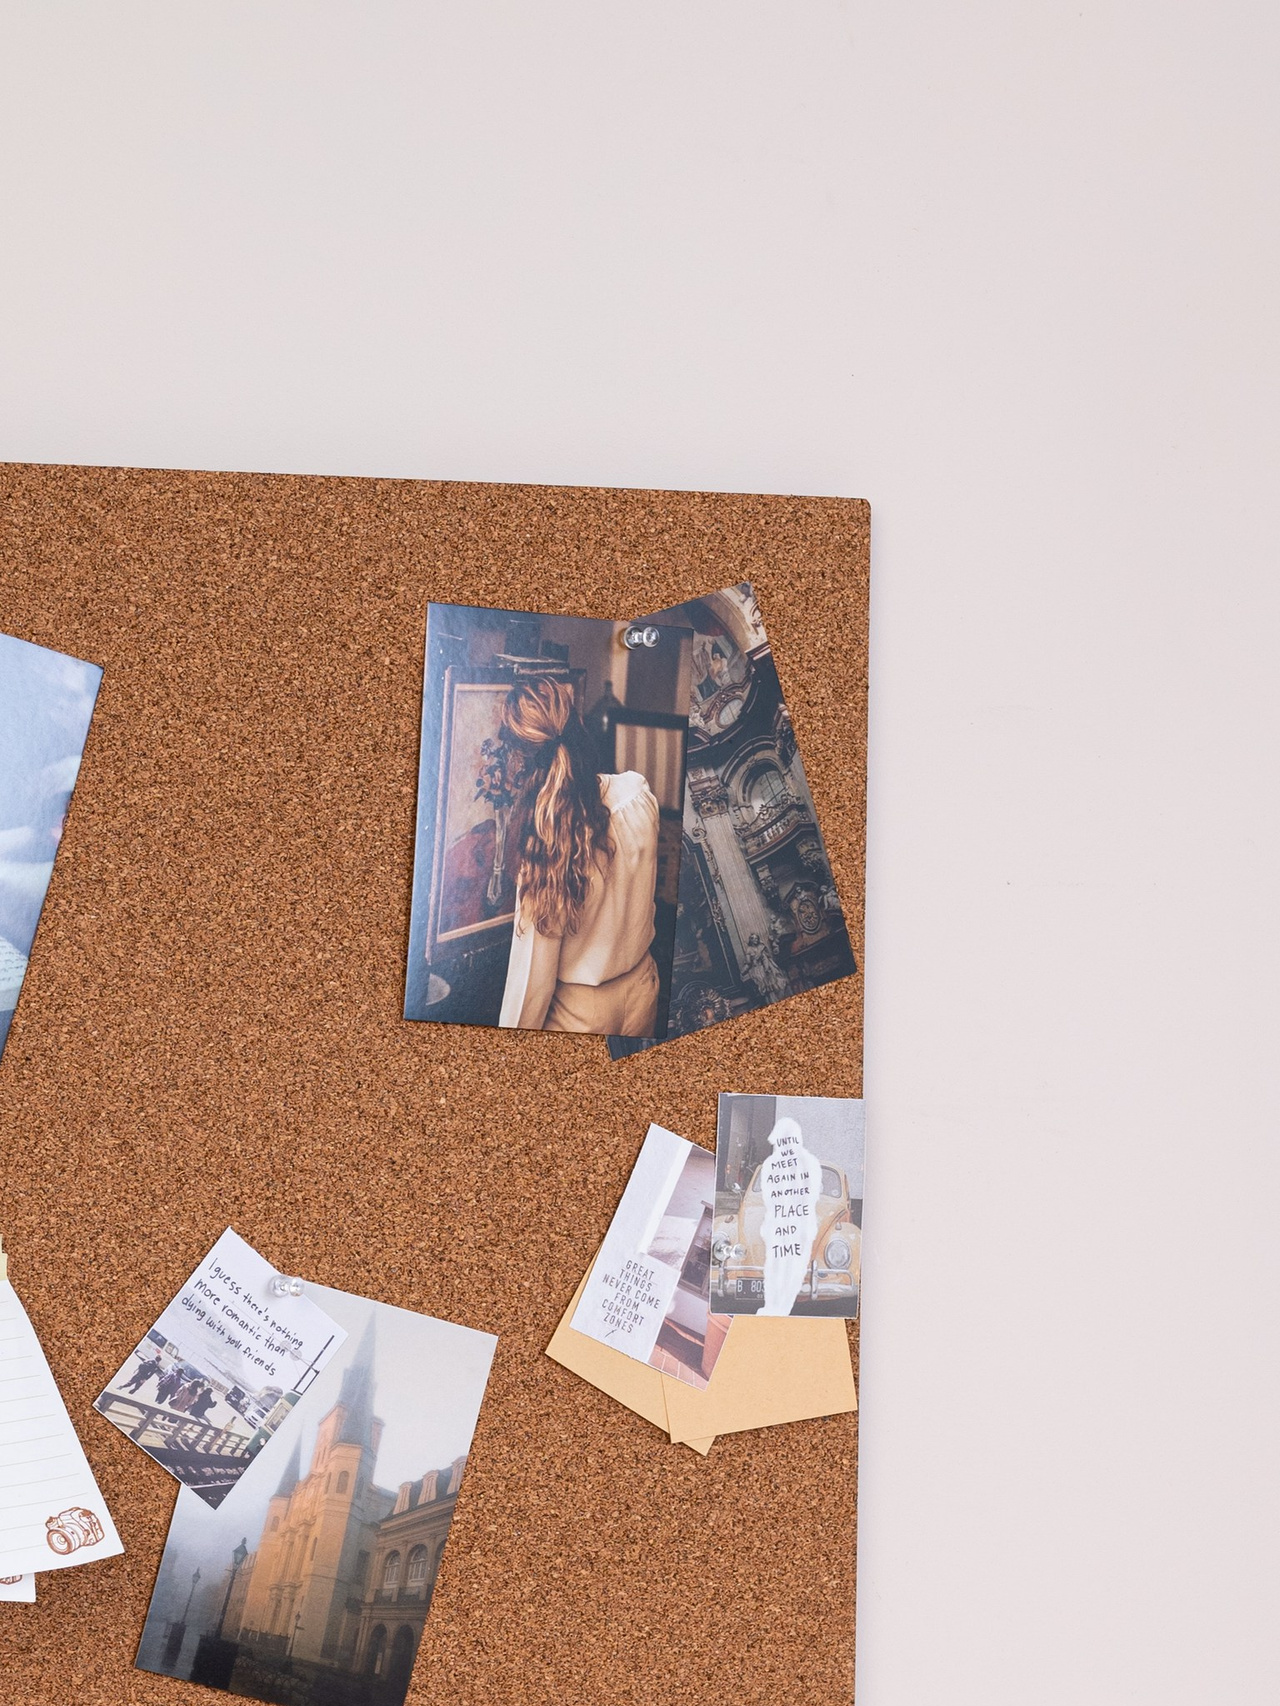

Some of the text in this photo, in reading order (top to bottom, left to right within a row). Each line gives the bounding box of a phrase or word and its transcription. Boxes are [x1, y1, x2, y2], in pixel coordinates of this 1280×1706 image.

[776, 1136, 799, 1147] UNTIL
[781, 1149, 794, 1157] WE
[771, 1158, 798, 1170] MEET
[766, 1172, 809, 1184] AGAIN IN
[771, 1187, 810, 1198] ANOTHER
[774, 1204, 809, 1218] PLACE
[775, 1225, 797, 1236] AND
[772, 1244, 801, 1258] TIME
[626, 1260, 655, 1280] GREAT
[620, 1269, 652, 1292] THINGS
[602, 1274, 660, 1309] NEVER COME
[208, 1257, 304, 1350] I guess there's nothing
[614, 1292, 640, 1311] FROM
[602, 1298, 644, 1326] COMFORT
[221, 1305, 262, 1340] romantic
[264, 1333, 286, 1356] than
[604, 1312, 633, 1333] ZONES
[181, 1294, 276, 1376] dying with your friends
